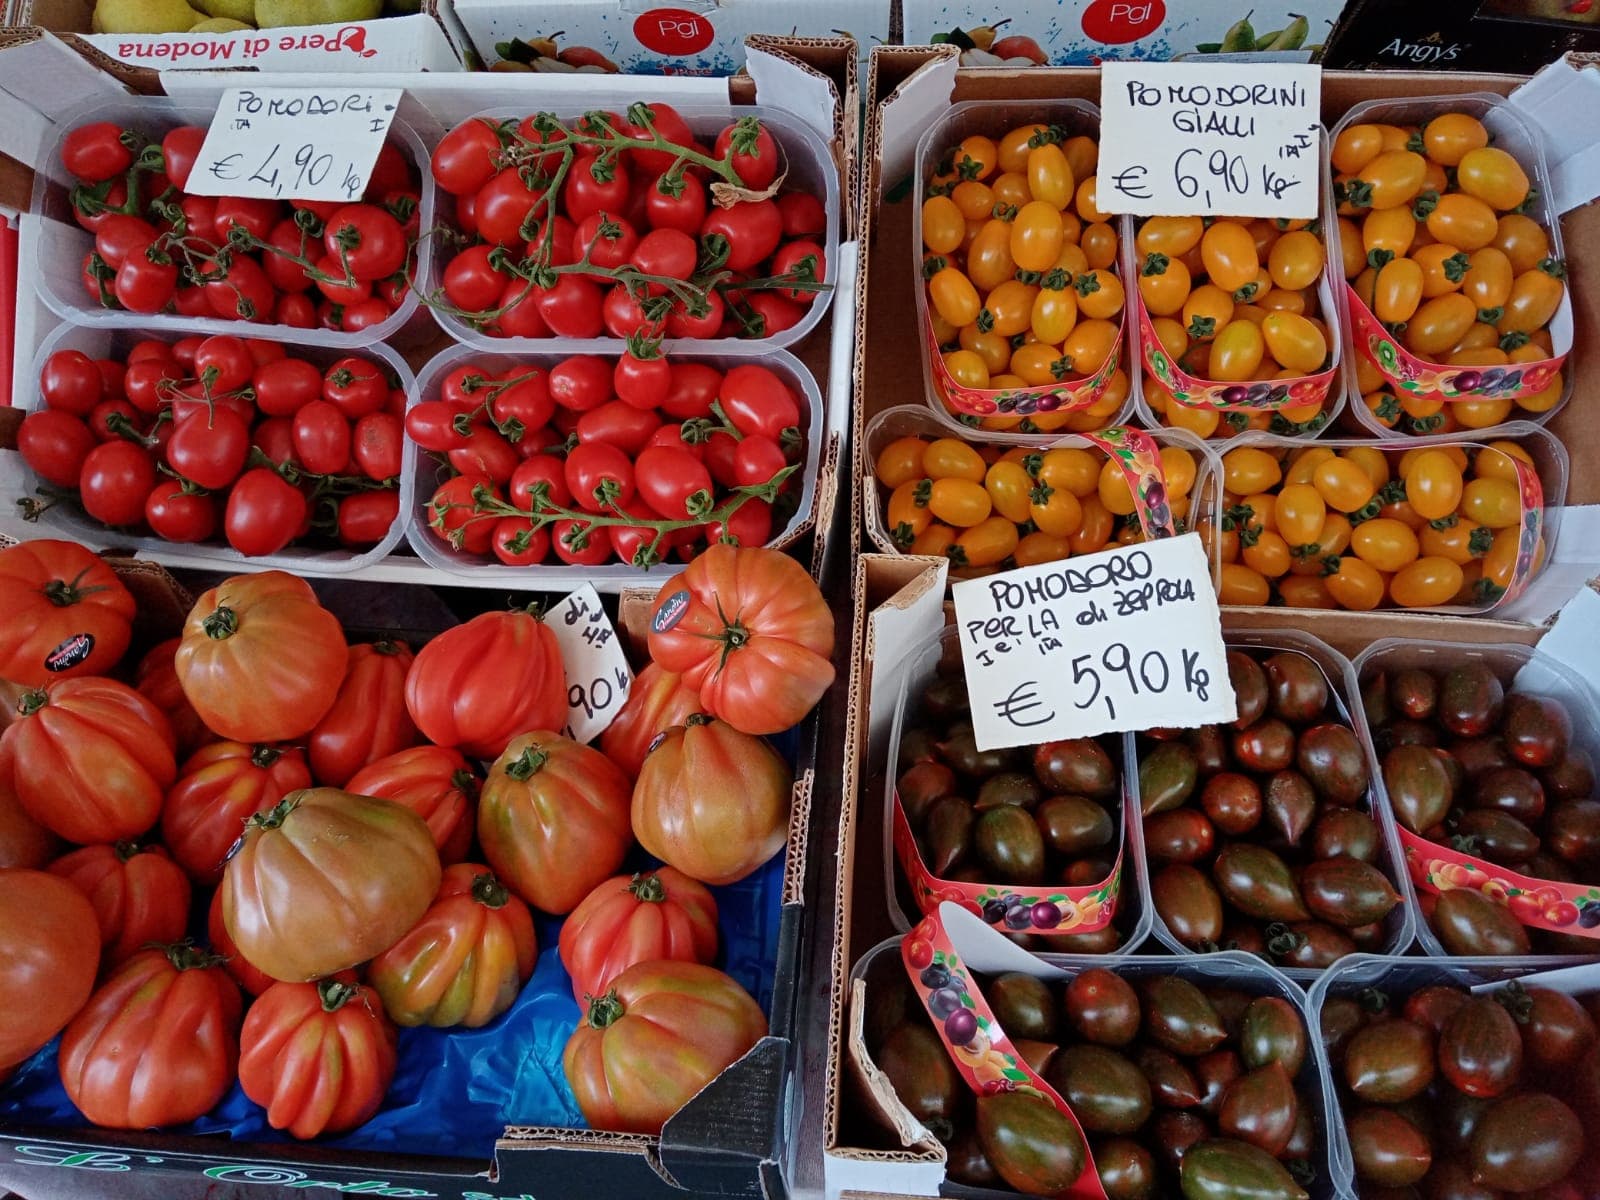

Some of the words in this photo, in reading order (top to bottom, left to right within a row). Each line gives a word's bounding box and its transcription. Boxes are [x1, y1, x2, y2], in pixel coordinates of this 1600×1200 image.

[118, 40, 236, 61] Modena
[242, 38, 270, 59] di
[278, 33, 342, 53] Pere
[1378, 38, 1462, 63] Angys
[1126, 80, 1306, 107] POMODORINI
[208, 153, 243, 180] €
[247, 143, 334, 196] 4,90
[1111, 165, 1153, 199] €
[1174, 148, 1249, 208] 6,90
[989, 550, 1153, 612] POMODORO
[993, 680, 1055, 727] €
[1071, 642, 1170, 720] 5,90
